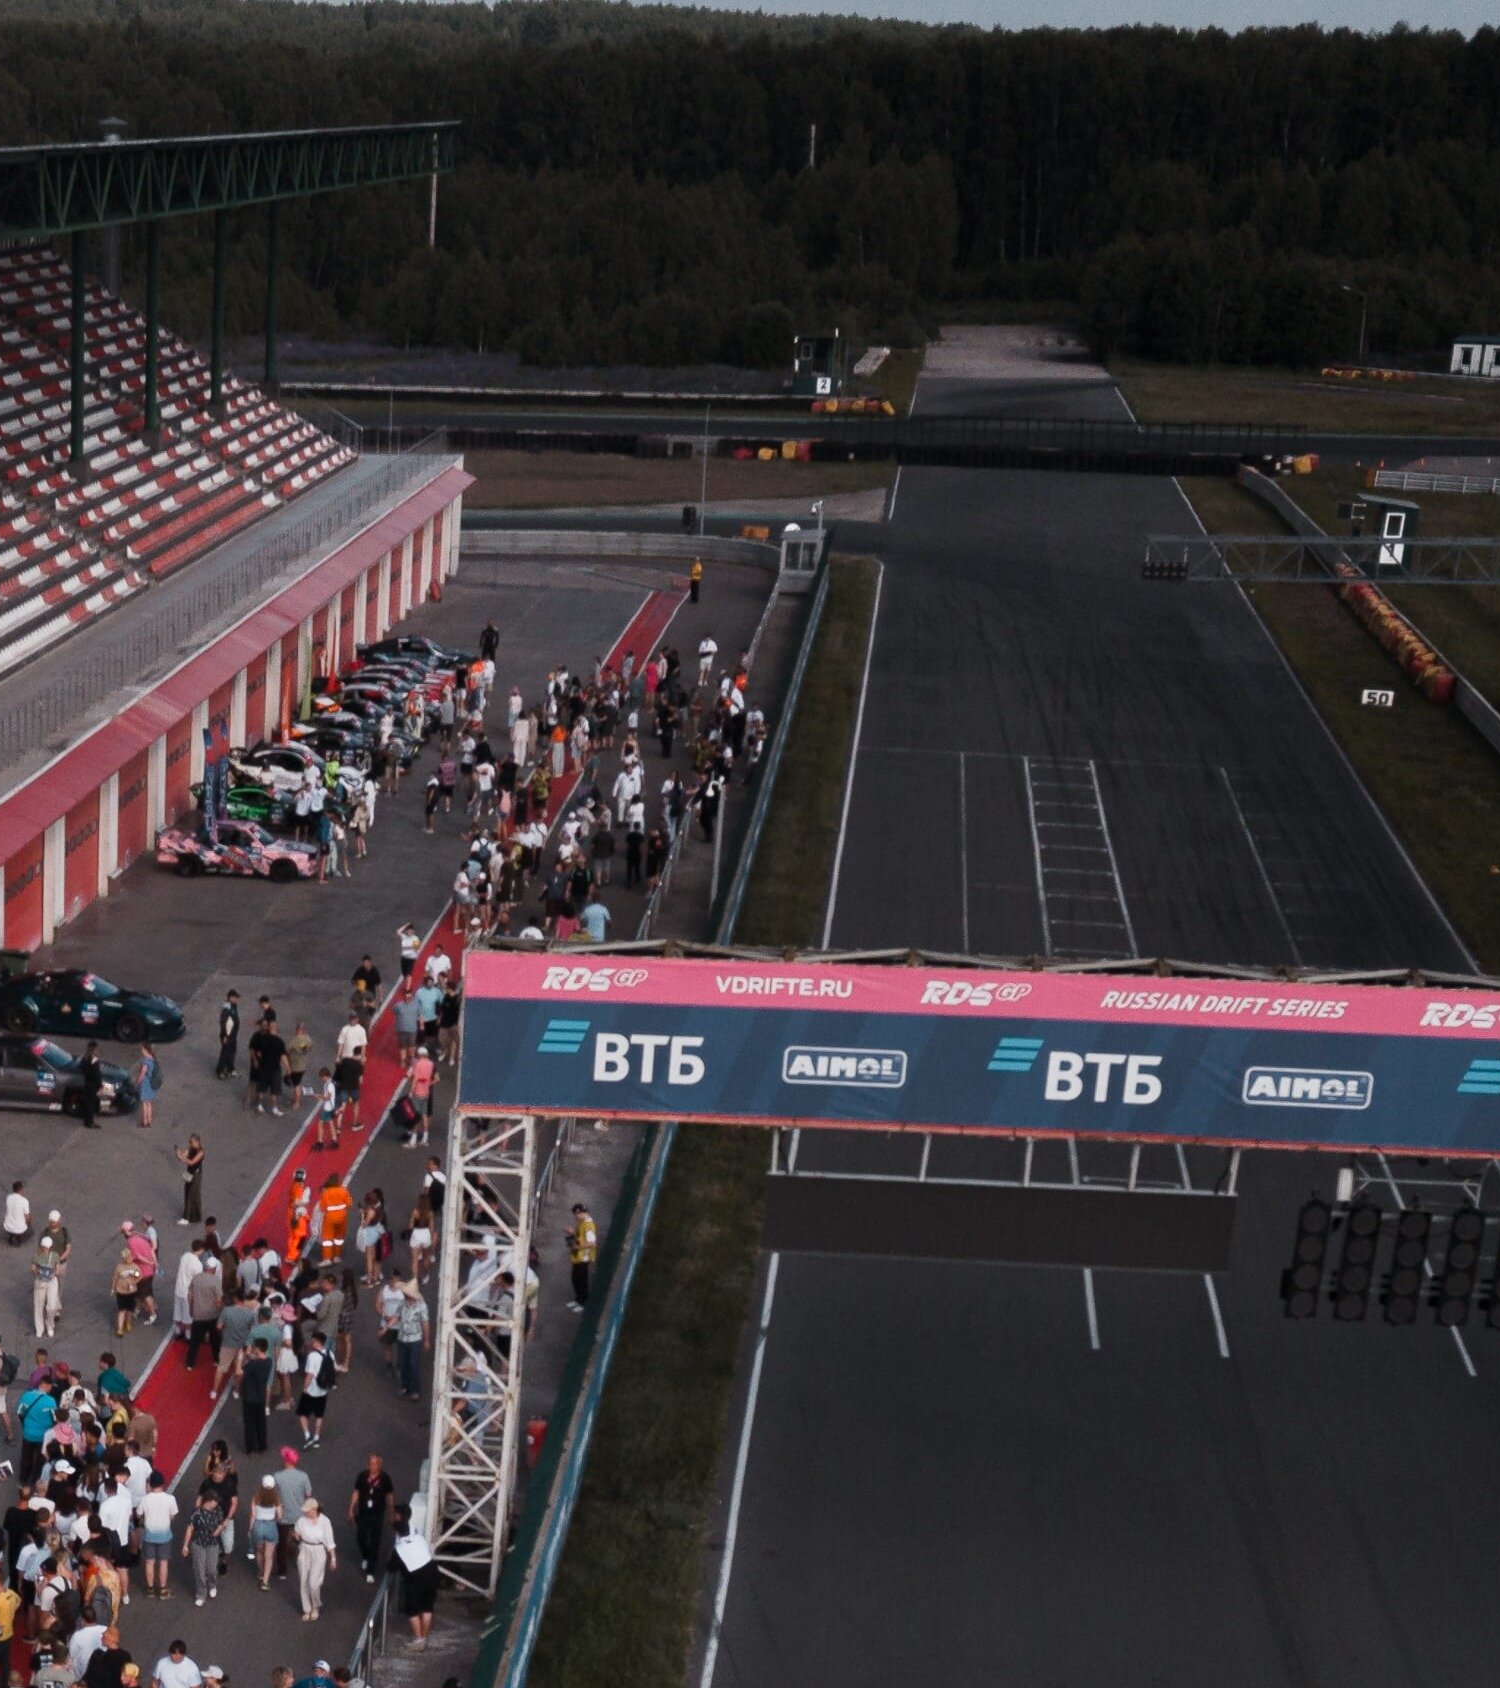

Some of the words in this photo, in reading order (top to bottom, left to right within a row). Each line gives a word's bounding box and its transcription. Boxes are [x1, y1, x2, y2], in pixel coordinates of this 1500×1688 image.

[1367, 692, 1390, 705] 50
[541, 966, 611, 991] RDS
[715, 975, 853, 998] VDRIFTE.RU
[919, 980, 996, 1006] RDS
[1101, 990, 1200, 1012] RUSSIAN
[1200, 995, 1269, 1015] DRIFT
[1267, 998, 1349, 1019] SERIES
[1419, 1002, 1499, 1029] RDS
[593, 1033, 705, 1085] ВТБ
[788, 1055, 900, 1078] AIMOL
[1045, 1051, 1163, 1104] ВТБ
[1248, 1076, 1364, 1102] AIMOL
